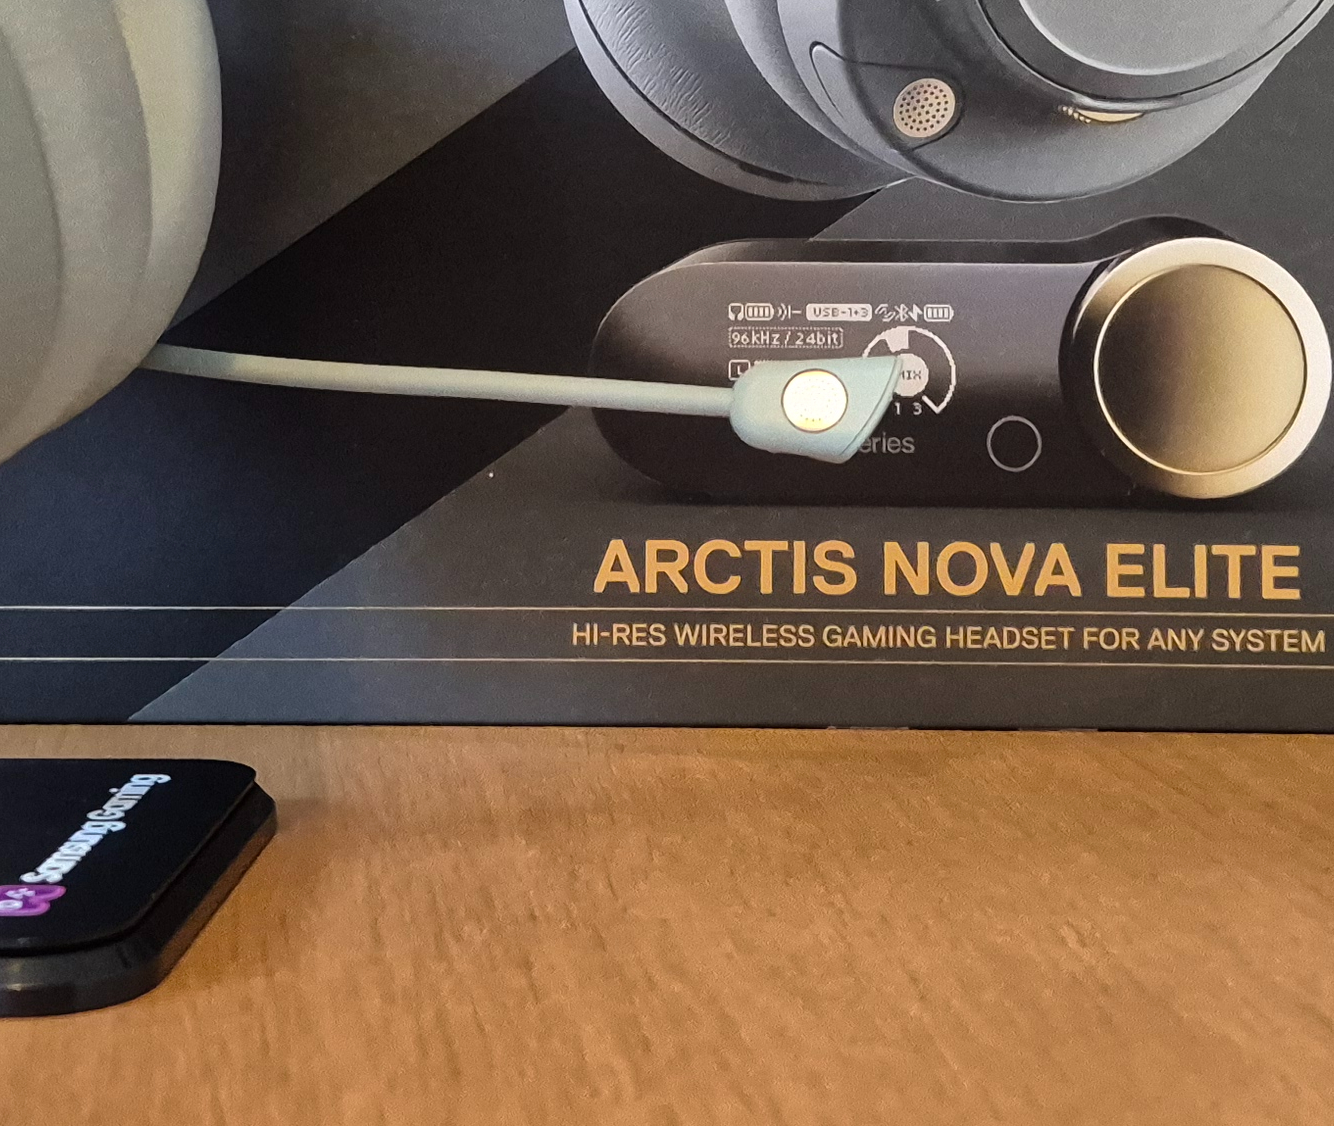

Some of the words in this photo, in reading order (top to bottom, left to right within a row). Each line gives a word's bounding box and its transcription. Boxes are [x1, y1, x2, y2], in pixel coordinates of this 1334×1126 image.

[912, 402, 923, 416] 3
[859, 431, 916, 454] eries
[593, 538, 858, 595] ARCTIS
[883, 541, 1082, 597] NOVA
[1106, 543, 1302, 600] ELITE
[572, 622, 666, 647] HI-RES
[673, 623, 816, 648] WIRELESS
[822, 625, 937, 649] GAMING
[945, 626, 1075, 650] HEADSET
[1083, 628, 1140, 651] FOR
[1147, 628, 1205, 652] ANY
[1211, 629, 1326, 653] SYSTEM
